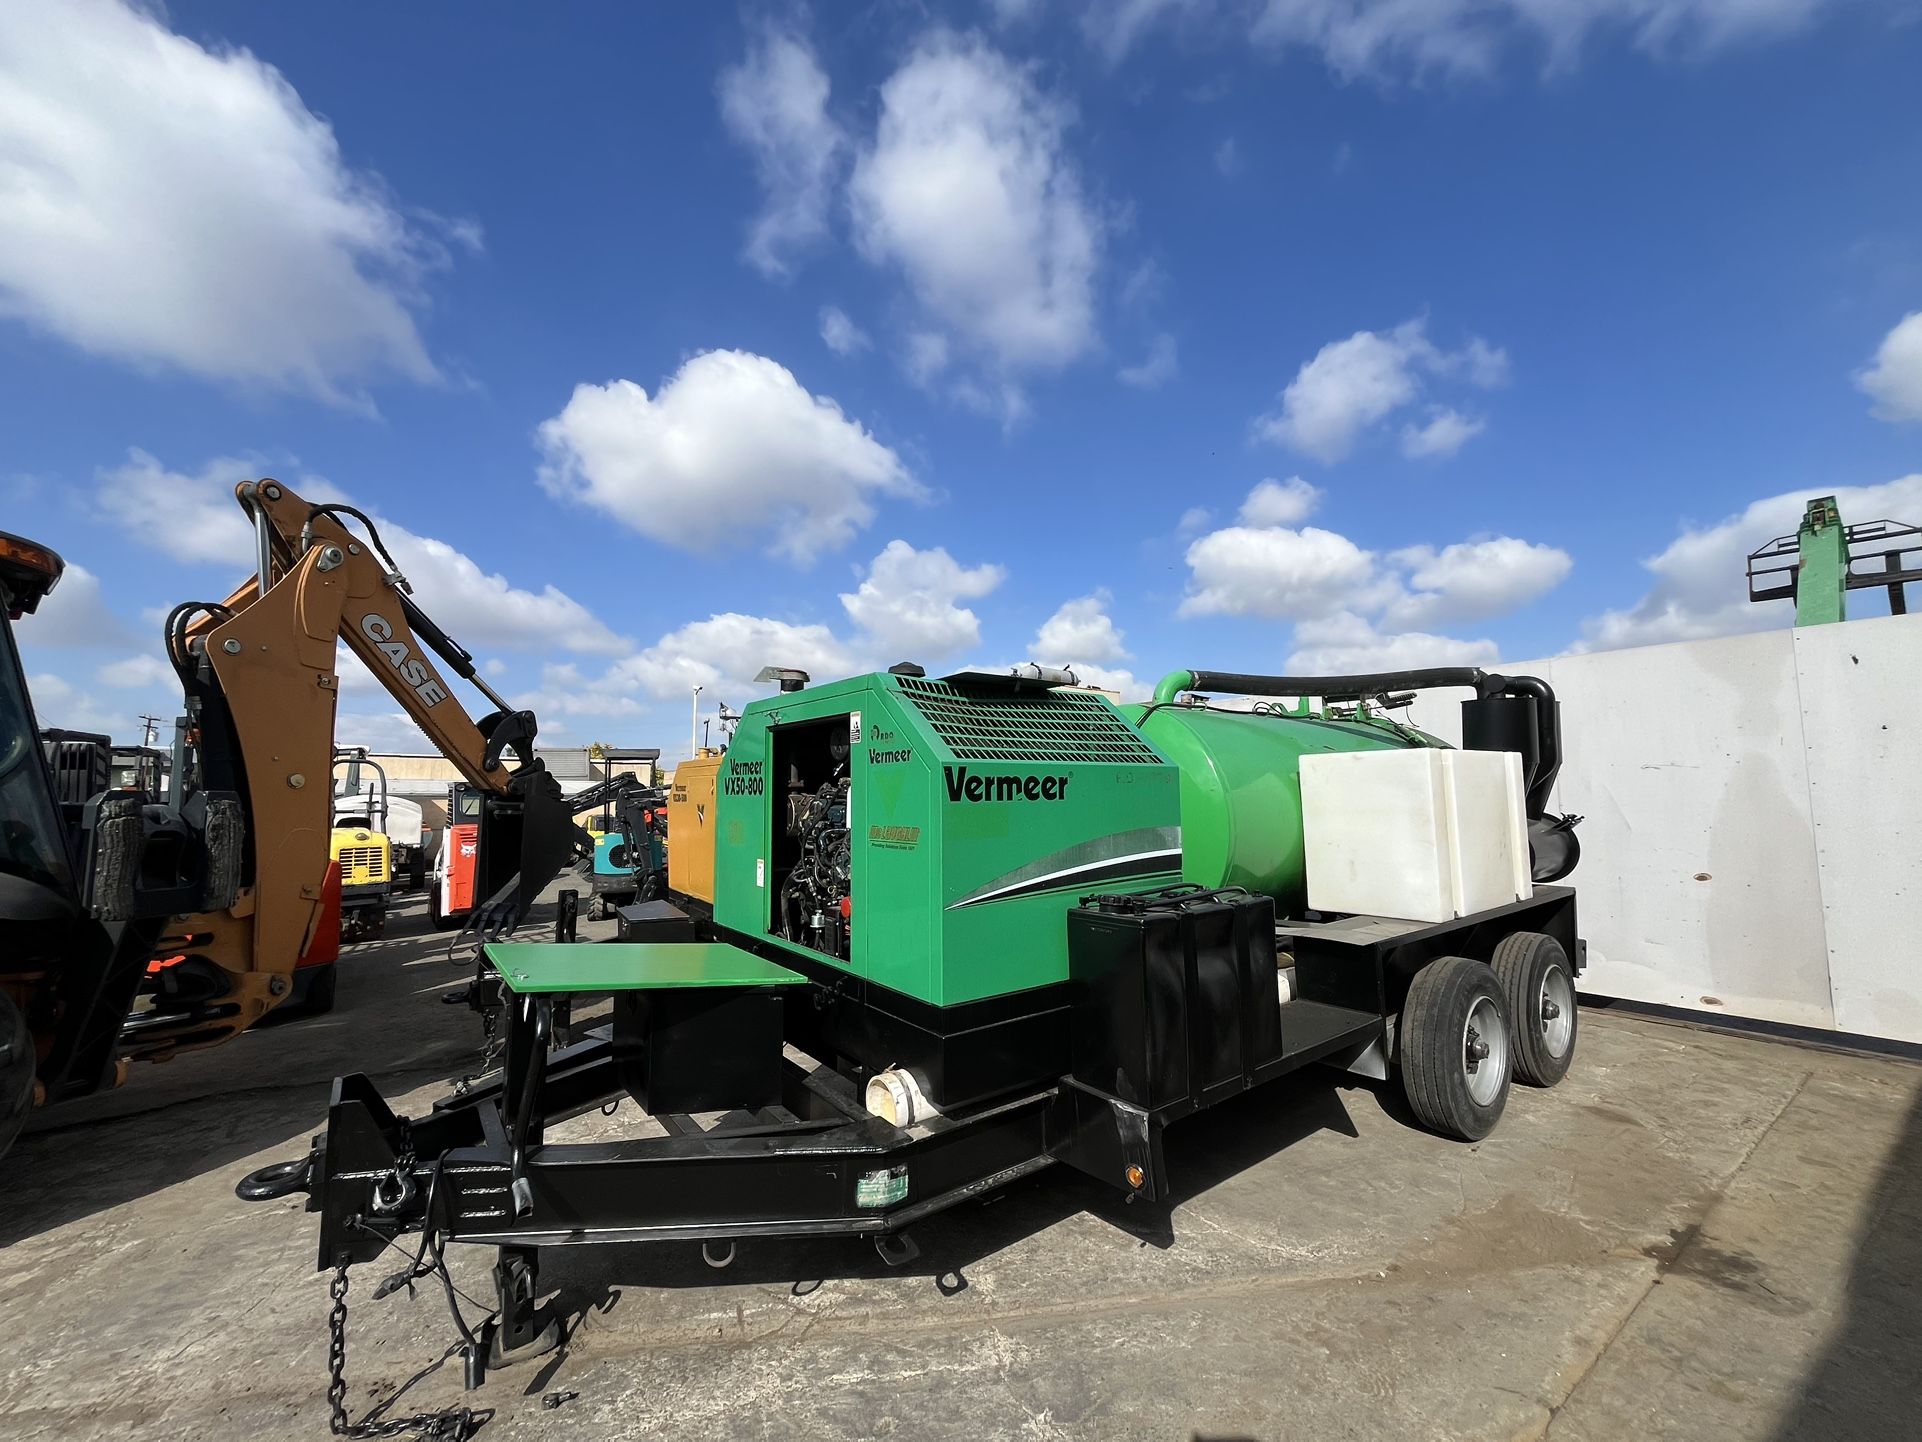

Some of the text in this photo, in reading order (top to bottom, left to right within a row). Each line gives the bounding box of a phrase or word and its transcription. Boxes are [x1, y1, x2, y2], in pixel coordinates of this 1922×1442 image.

[361, 613, 448, 708] CASE
[730, 758, 762, 775] Vermeer
[869, 748, 911, 764] Vermeer
[943, 766, 1068, 802] Vermeer
